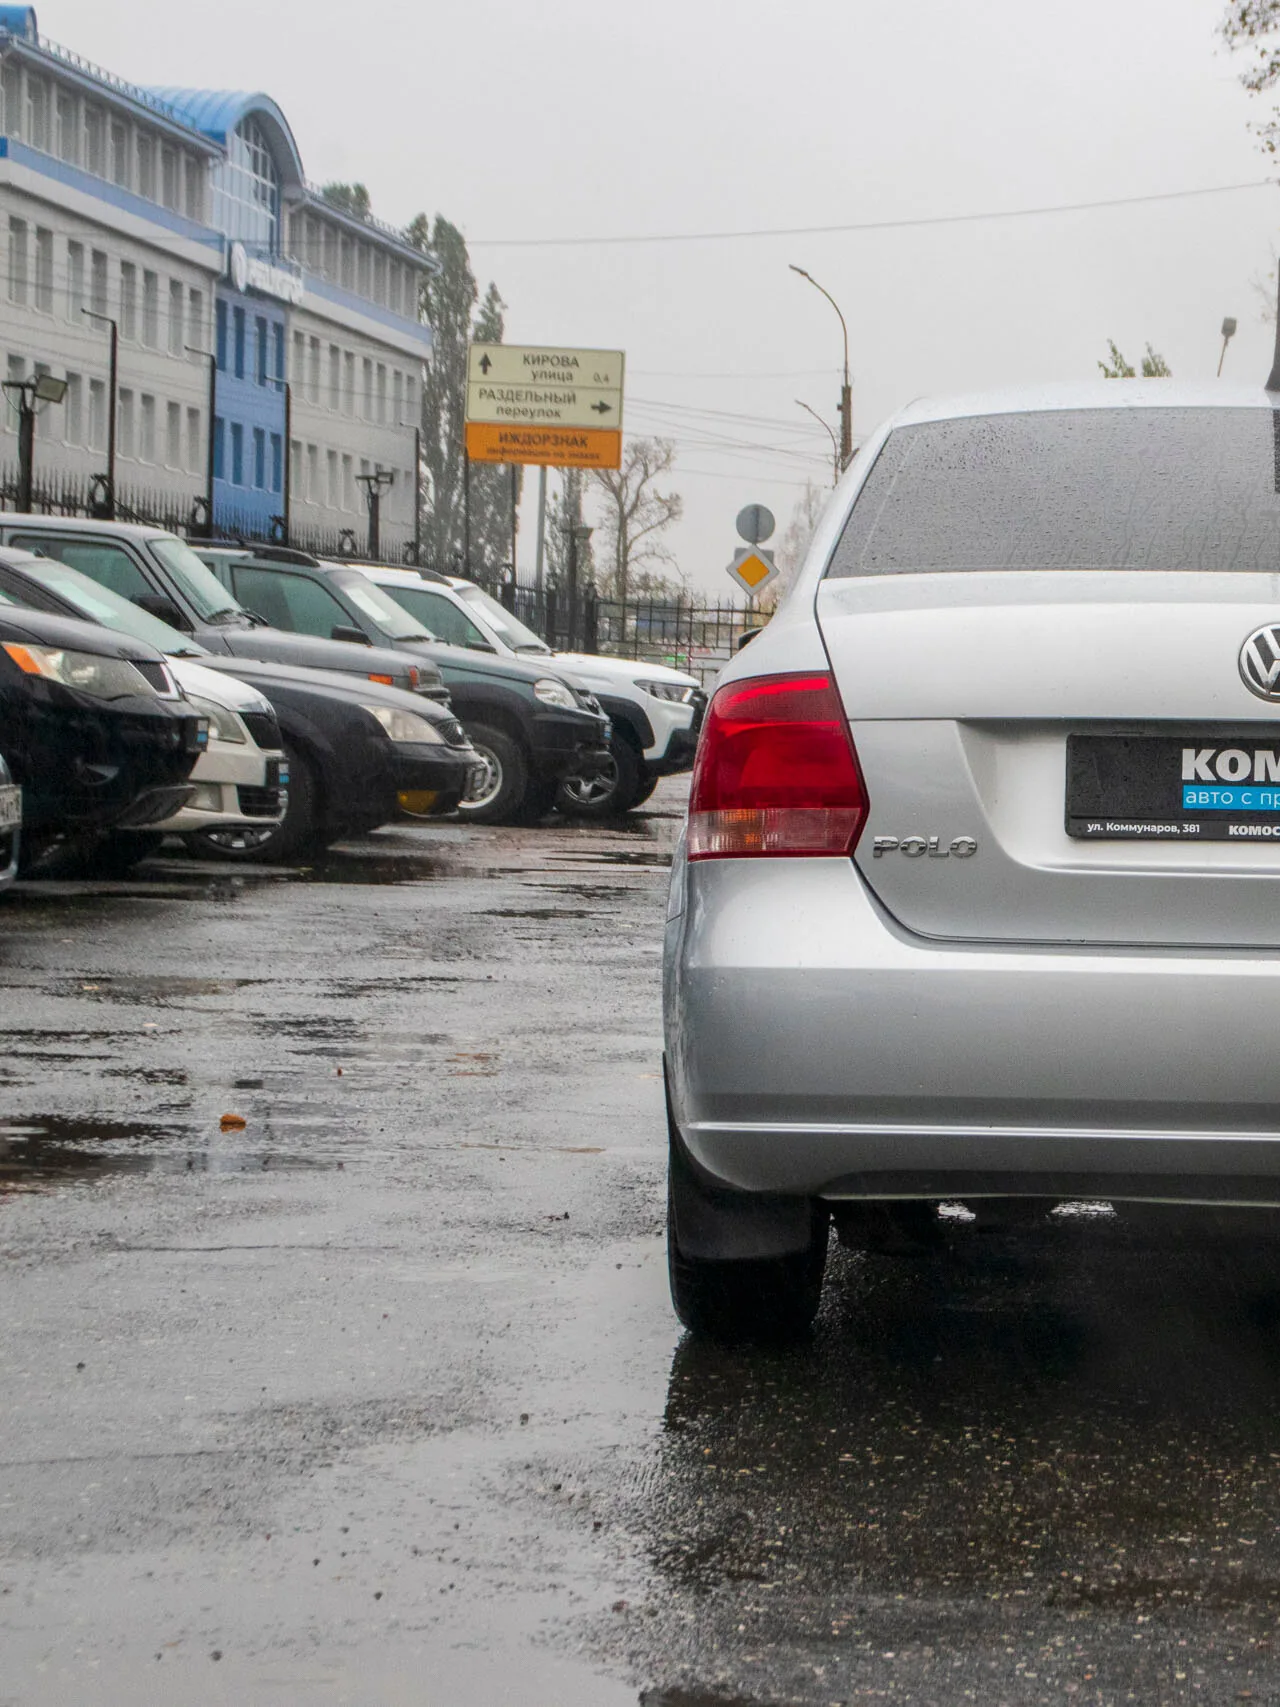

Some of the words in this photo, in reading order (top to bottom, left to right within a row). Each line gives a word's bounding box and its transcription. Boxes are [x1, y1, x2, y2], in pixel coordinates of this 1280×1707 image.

[523, 353, 580, 368] КИРОВА
[531, 369, 574, 382] улица
[479, 387, 577, 405] РАЗДЕЛЬНЫЙ
[496, 405, 562, 419] переулок
[499, 431, 588, 448] ИЖДОРЗНАК
[1185, 791, 1234, 805] авто
[1241, 792, 1253, 805] с
[1087, 822, 1103, 833] ул.
[1106, 822, 1181, 834] Коммунаров,
[1182, 823, 1200, 833] 381
[1228, 825, 1280, 836] КОМОС
[873, 835, 978, 858] POLO
